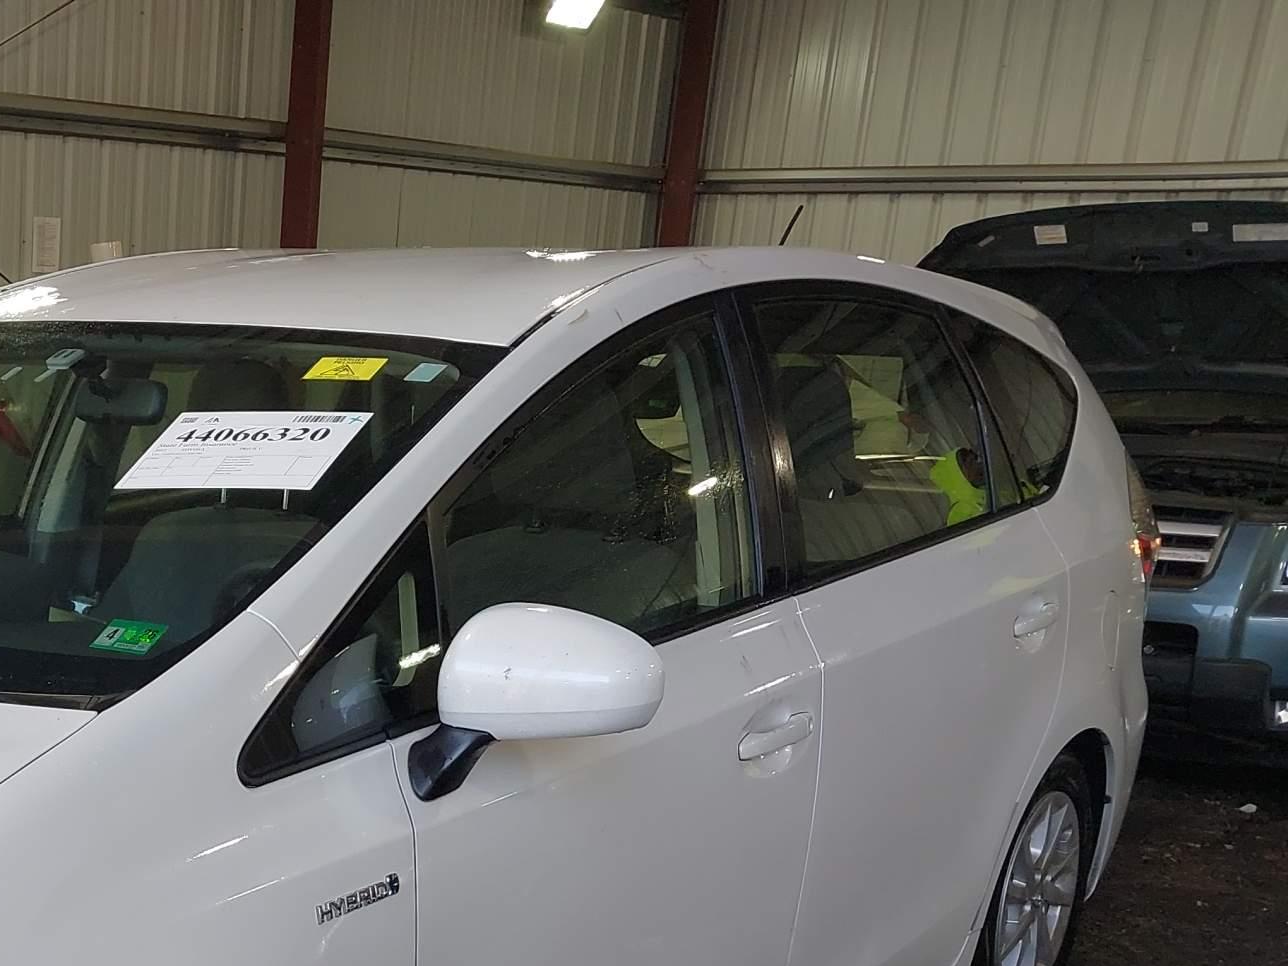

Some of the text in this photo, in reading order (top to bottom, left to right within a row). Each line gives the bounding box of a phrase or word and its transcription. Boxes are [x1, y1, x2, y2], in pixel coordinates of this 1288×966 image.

[175, 427, 331, 443] 44066320
[106, 628, 120, 640] 4
[314, 880, 390, 926] HYBRID
